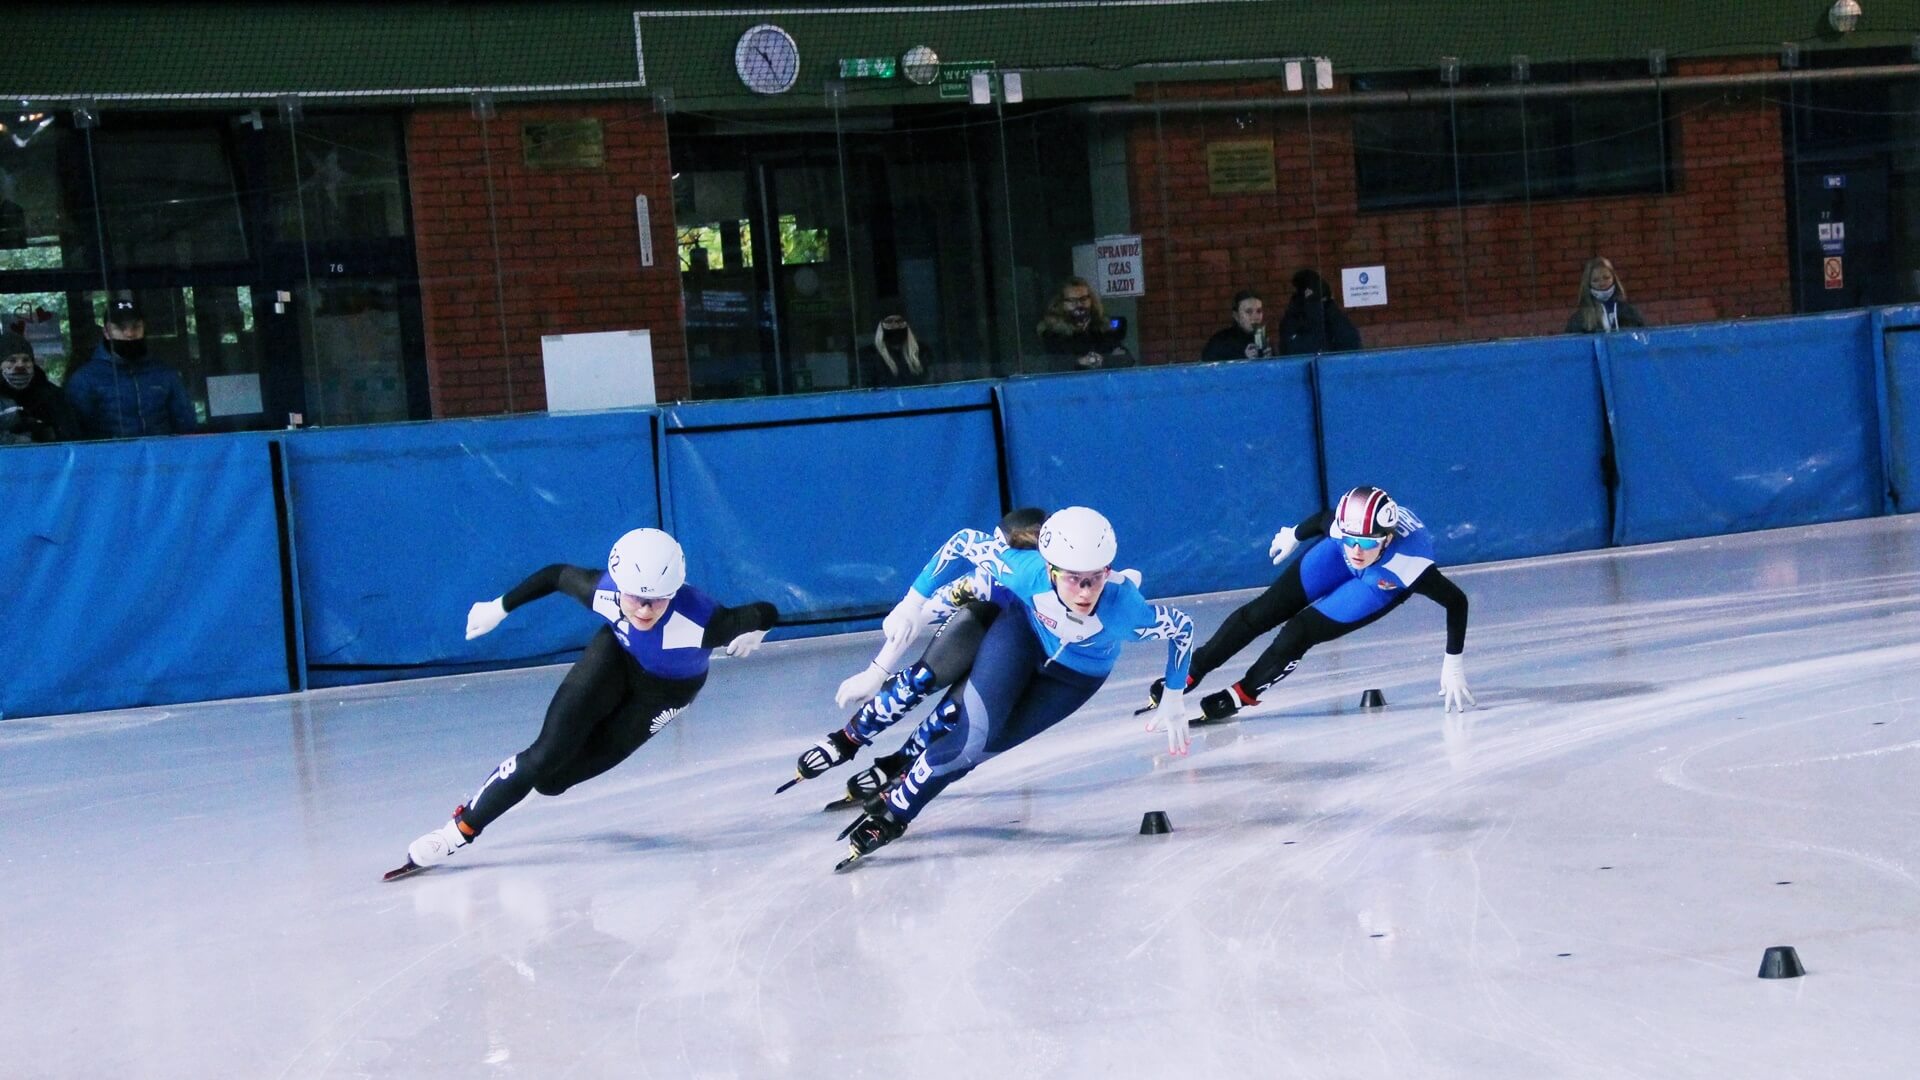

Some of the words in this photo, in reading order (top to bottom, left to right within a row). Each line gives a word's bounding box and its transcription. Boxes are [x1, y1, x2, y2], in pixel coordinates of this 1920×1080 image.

[1828, 177, 1842, 186] WC
[330, 263, 344, 273] 76
[1108, 261, 1132, 275] CZAS
[1106, 278, 1135, 293] JAZDY
